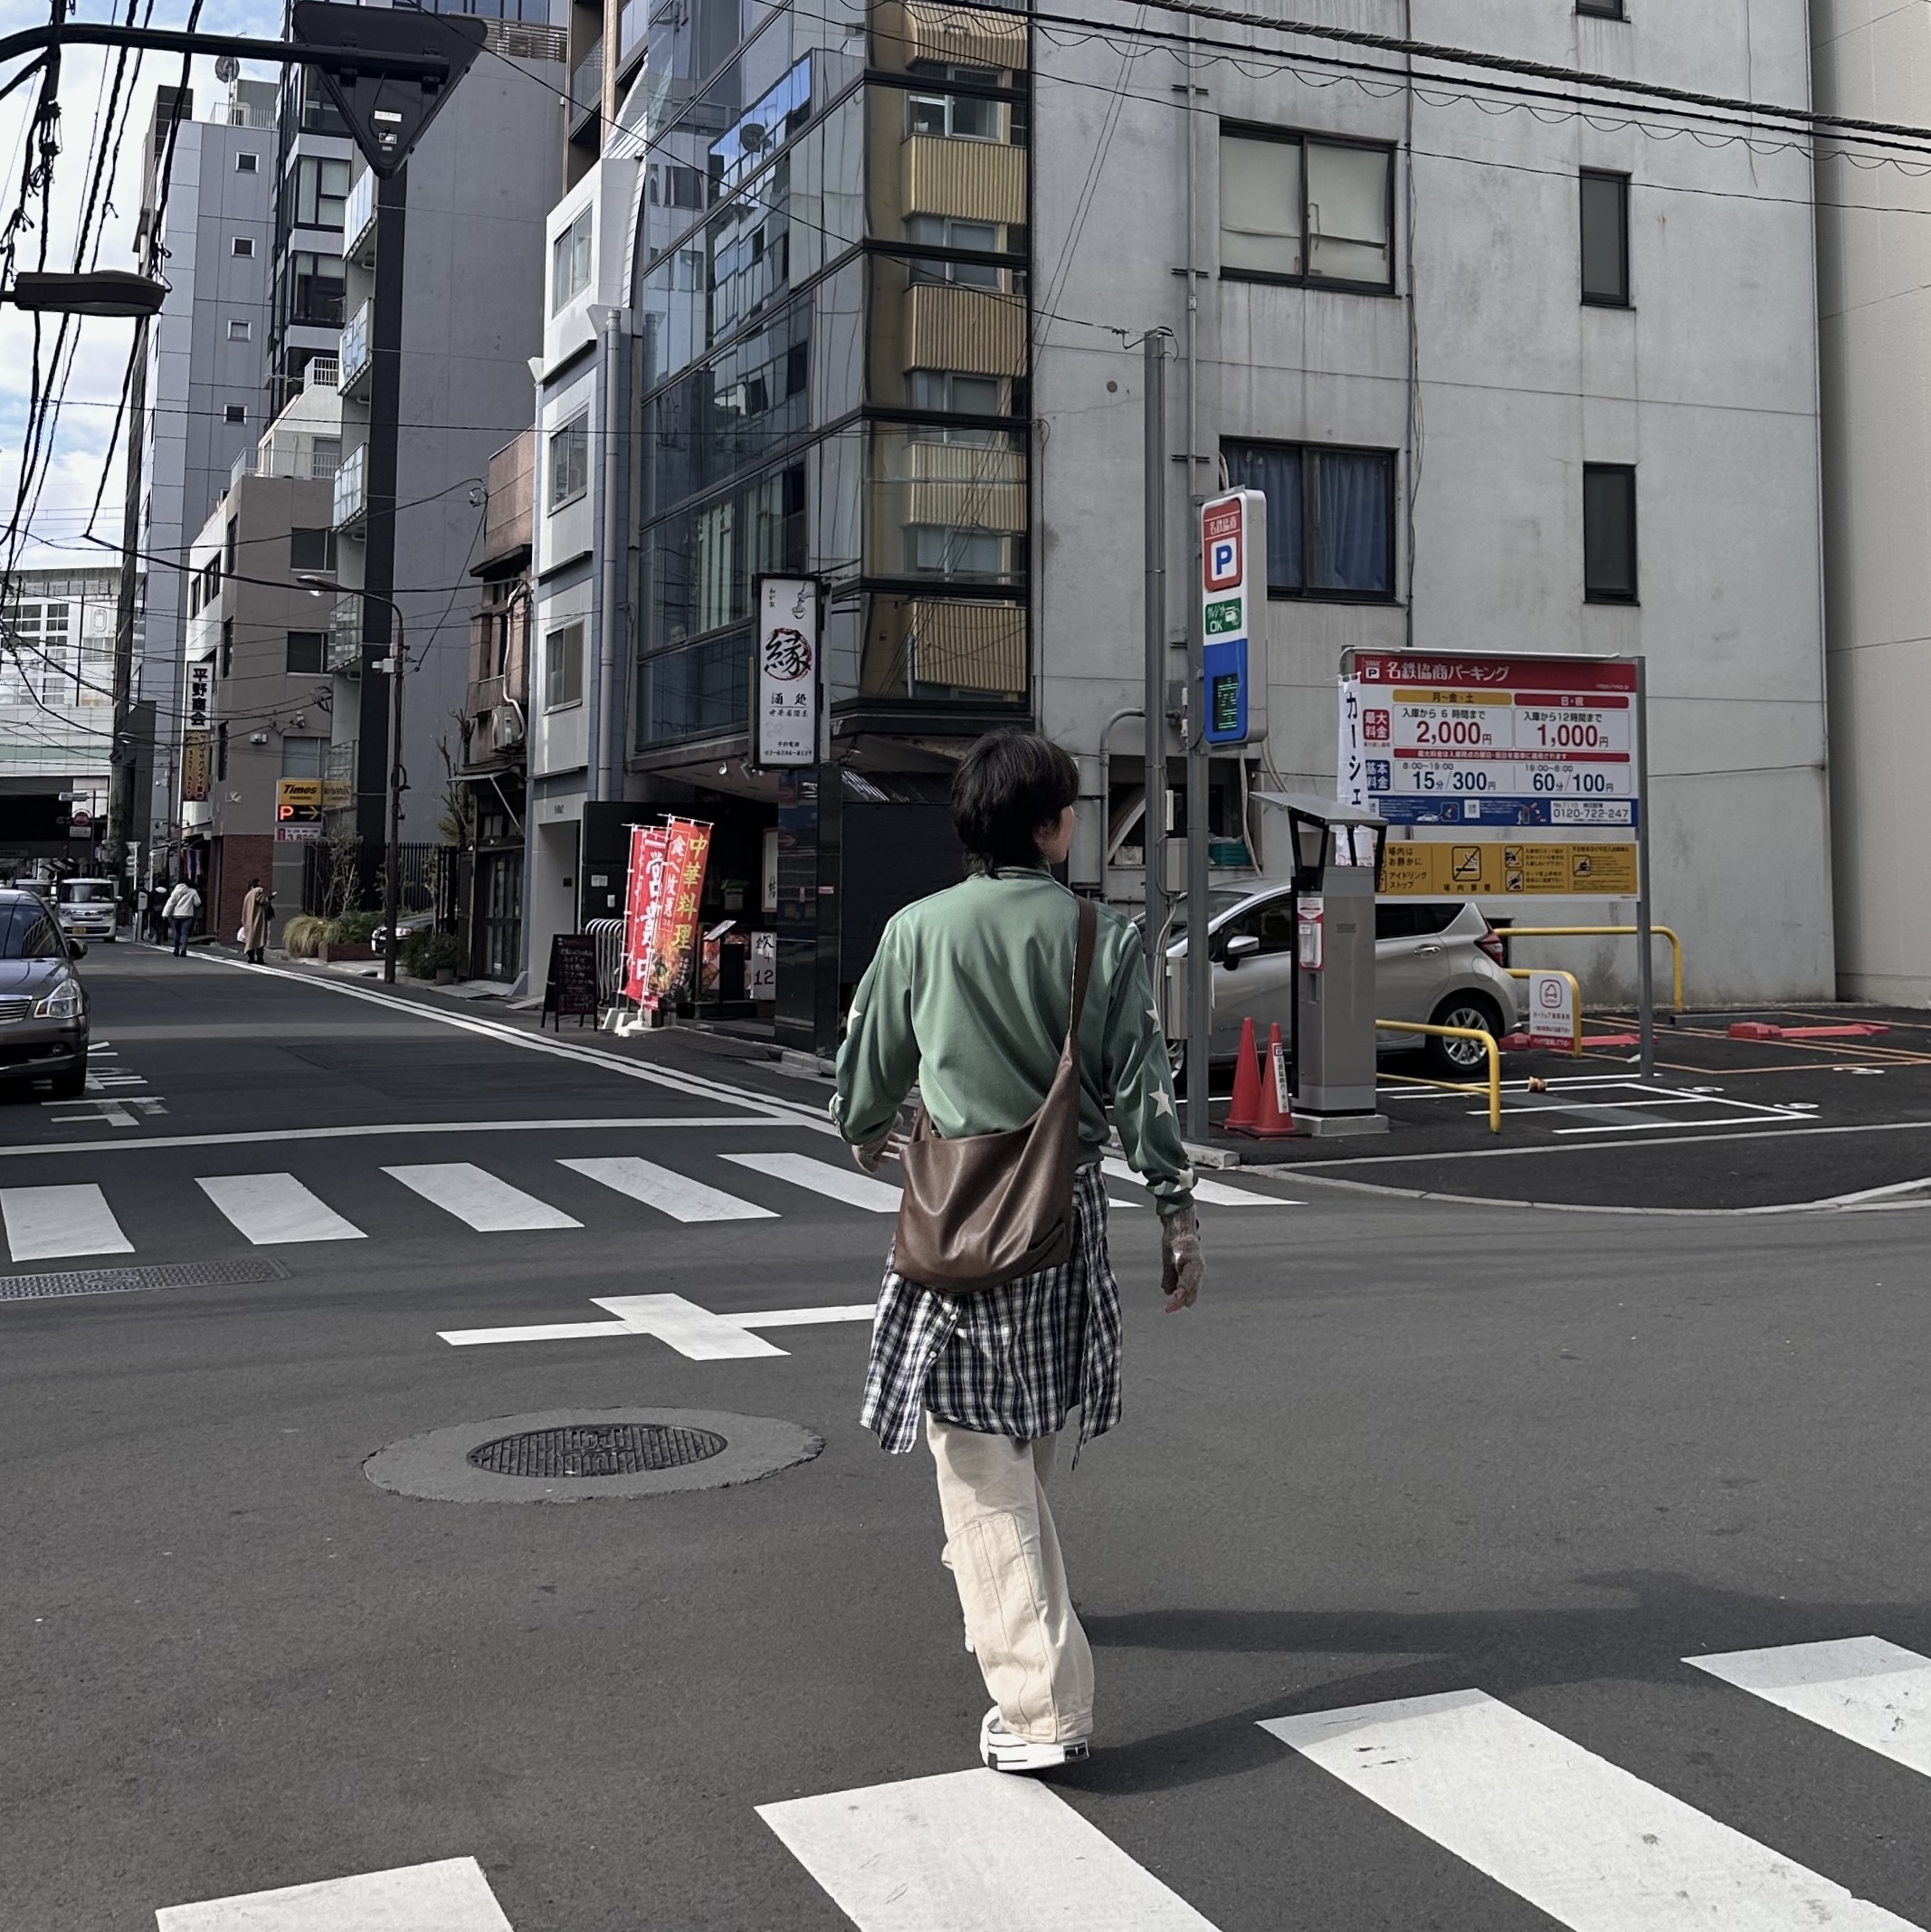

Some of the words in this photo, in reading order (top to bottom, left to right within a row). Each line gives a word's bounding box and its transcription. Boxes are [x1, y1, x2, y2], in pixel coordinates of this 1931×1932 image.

[1216, 545, 1232, 576] P
[1210, 619, 1223, 633] OK
[765, 632, 810, 679] 縁
[1368, 669, 1377, 677] P
[1386, 661, 1509, 682] 名鉄協商パーキング
[191, 668, 208, 727] 平野商会
[1365, 712, 1388, 724] 最大
[1365, 725, 1388, 738] 料金
[1416, 720, 1492, 746] 2,000円
[1536, 724, 1609, 747] 1,000円
[283, 784, 319, 795] Times
[280, 805, 294, 821] P
[1553, 808, 1629, 818] 0120-722-247
[1389, 871, 1427, 880] アイドリング
[671, 833, 709, 950] 中華料理
[1389, 881, 1413, 890] ストップ
[754, 970, 775, 985] 12
